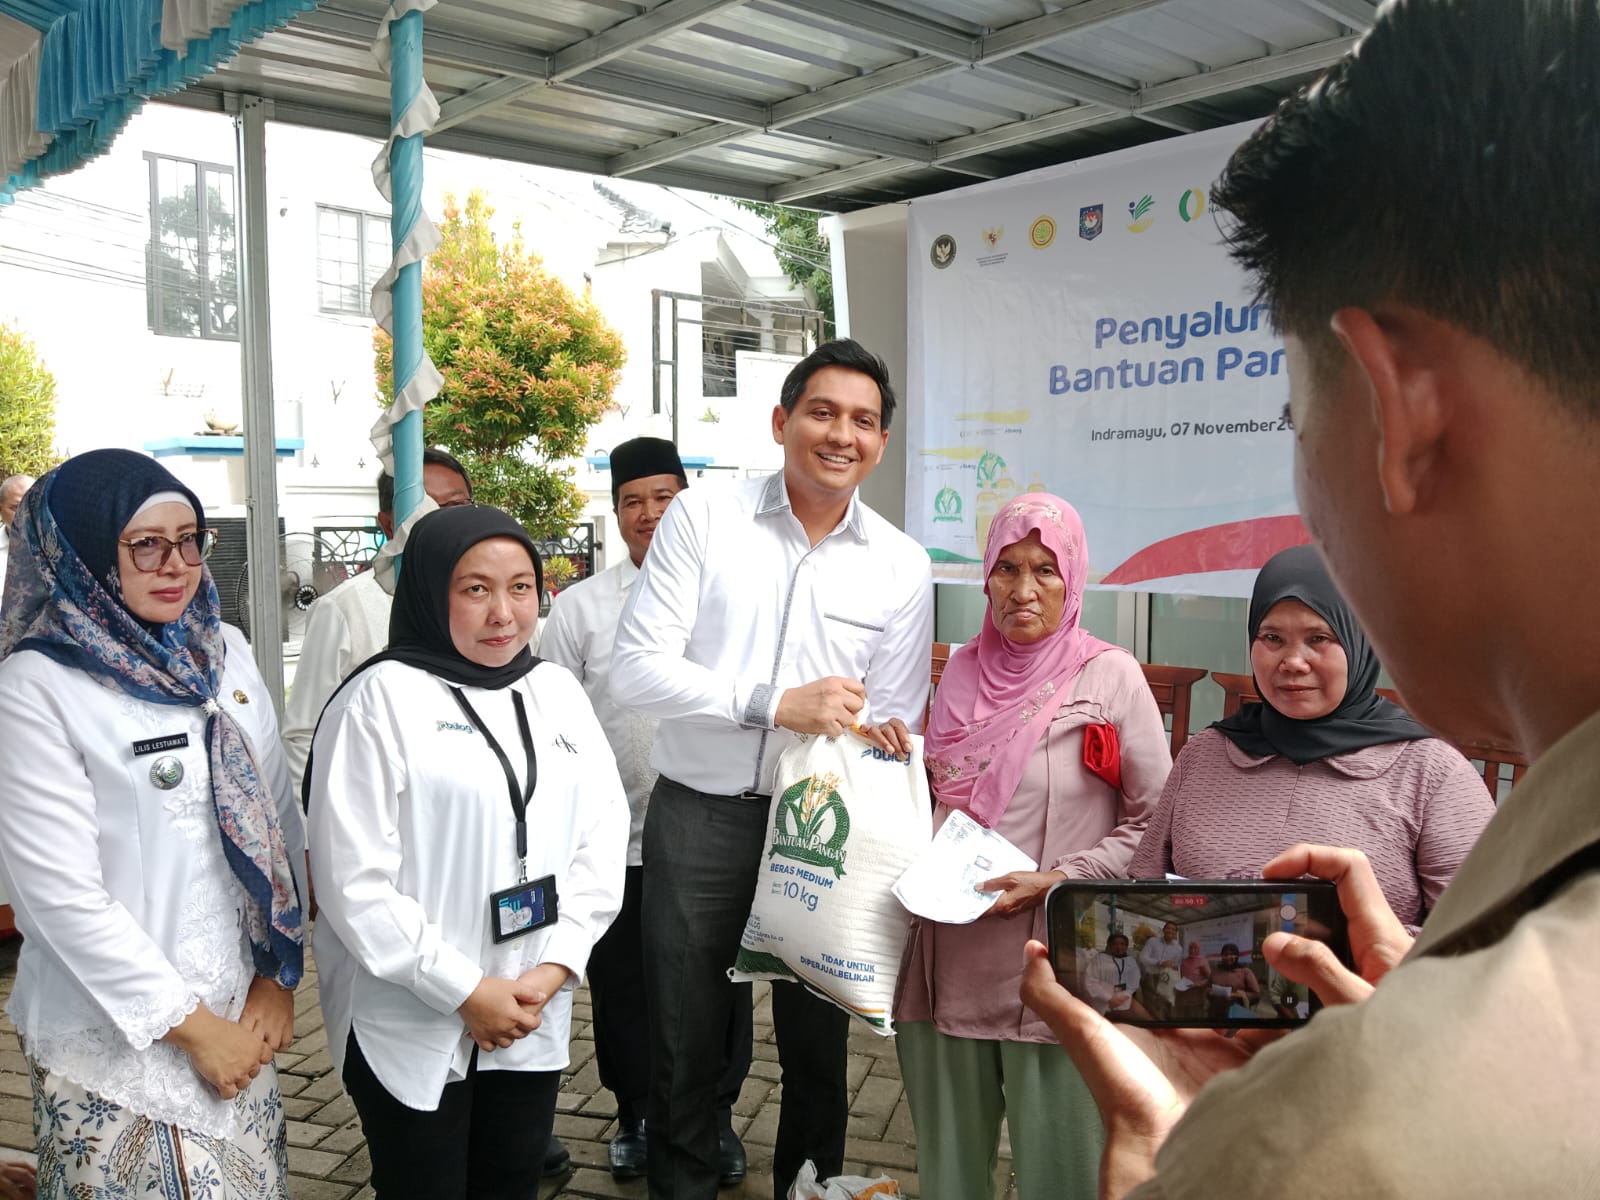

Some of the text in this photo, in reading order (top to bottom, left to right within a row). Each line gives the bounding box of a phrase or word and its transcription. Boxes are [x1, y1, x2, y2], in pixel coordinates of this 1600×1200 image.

[1095, 301, 1269, 349] Penyalur
[1049, 357, 1204, 396] Bantuan
[1091, 427, 1166, 441] Indramayu,
[1170, 422, 1190, 436] 07
[770, 863, 795, 875] BERAS
[796, 868, 834, 889] MEDIUM
[800, 956, 875, 982] DIPERJUALBELIKAN
[821, 953, 876, 973] TIDAK UNTUK
